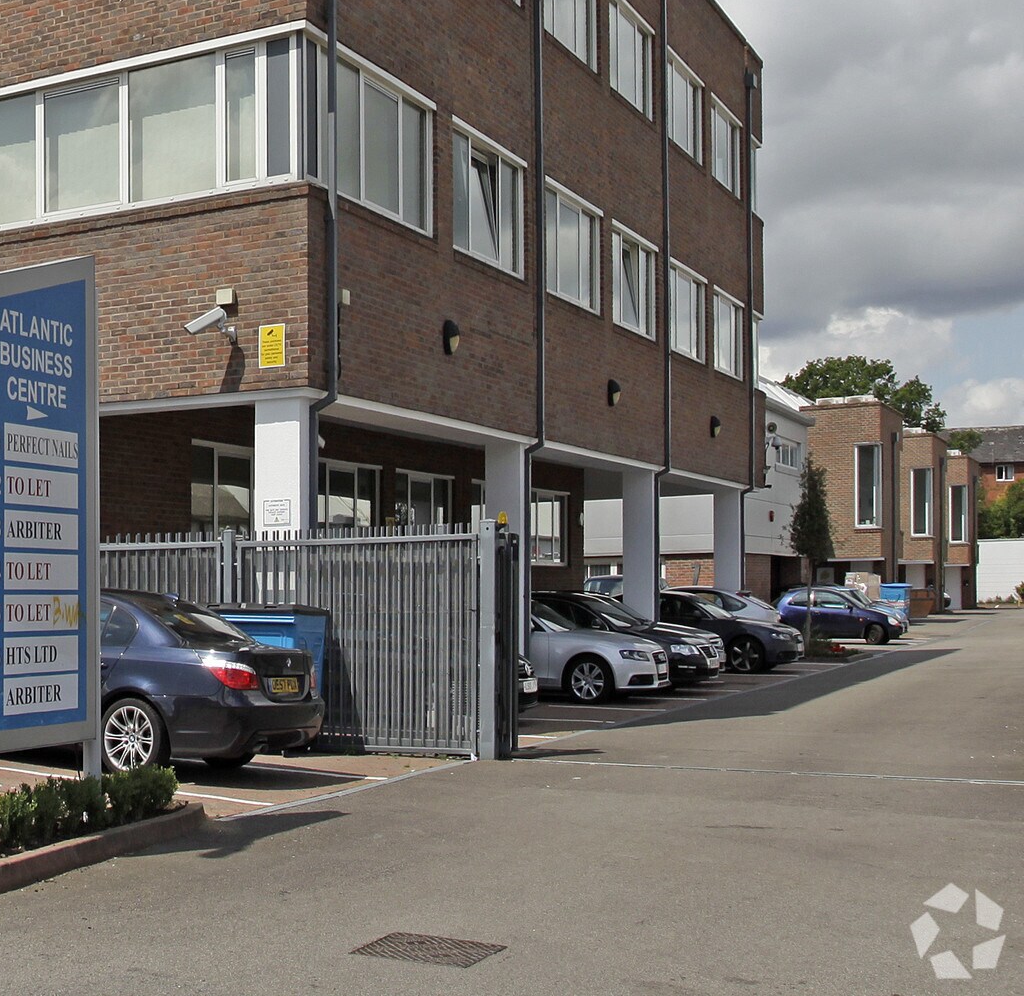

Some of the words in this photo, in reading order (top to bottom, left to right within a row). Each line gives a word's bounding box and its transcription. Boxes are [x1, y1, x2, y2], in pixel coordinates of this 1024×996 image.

[0, 308, 73, 347] ATLANTIC
[0, 341, 73, 379] BUSINESS
[6, 375, 67, 409] CENTRE
[7, 433, 50, 456] PERFECT
[52, 439, 79, 460] NAILS
[7, 476, 25, 495] TO
[28, 478, 51, 497] LET
[7, 520, 62, 541] ARBITER
[6, 561, 24, 580] TO
[27, 562, 51, 581] LET
[6, 604, 24, 622] TO
[27, 604, 51, 622] LET
[6, 646, 31, 665] HTS
[34, 645, 57, 664] LTD
[6, 684, 61, 706] ARBITER
